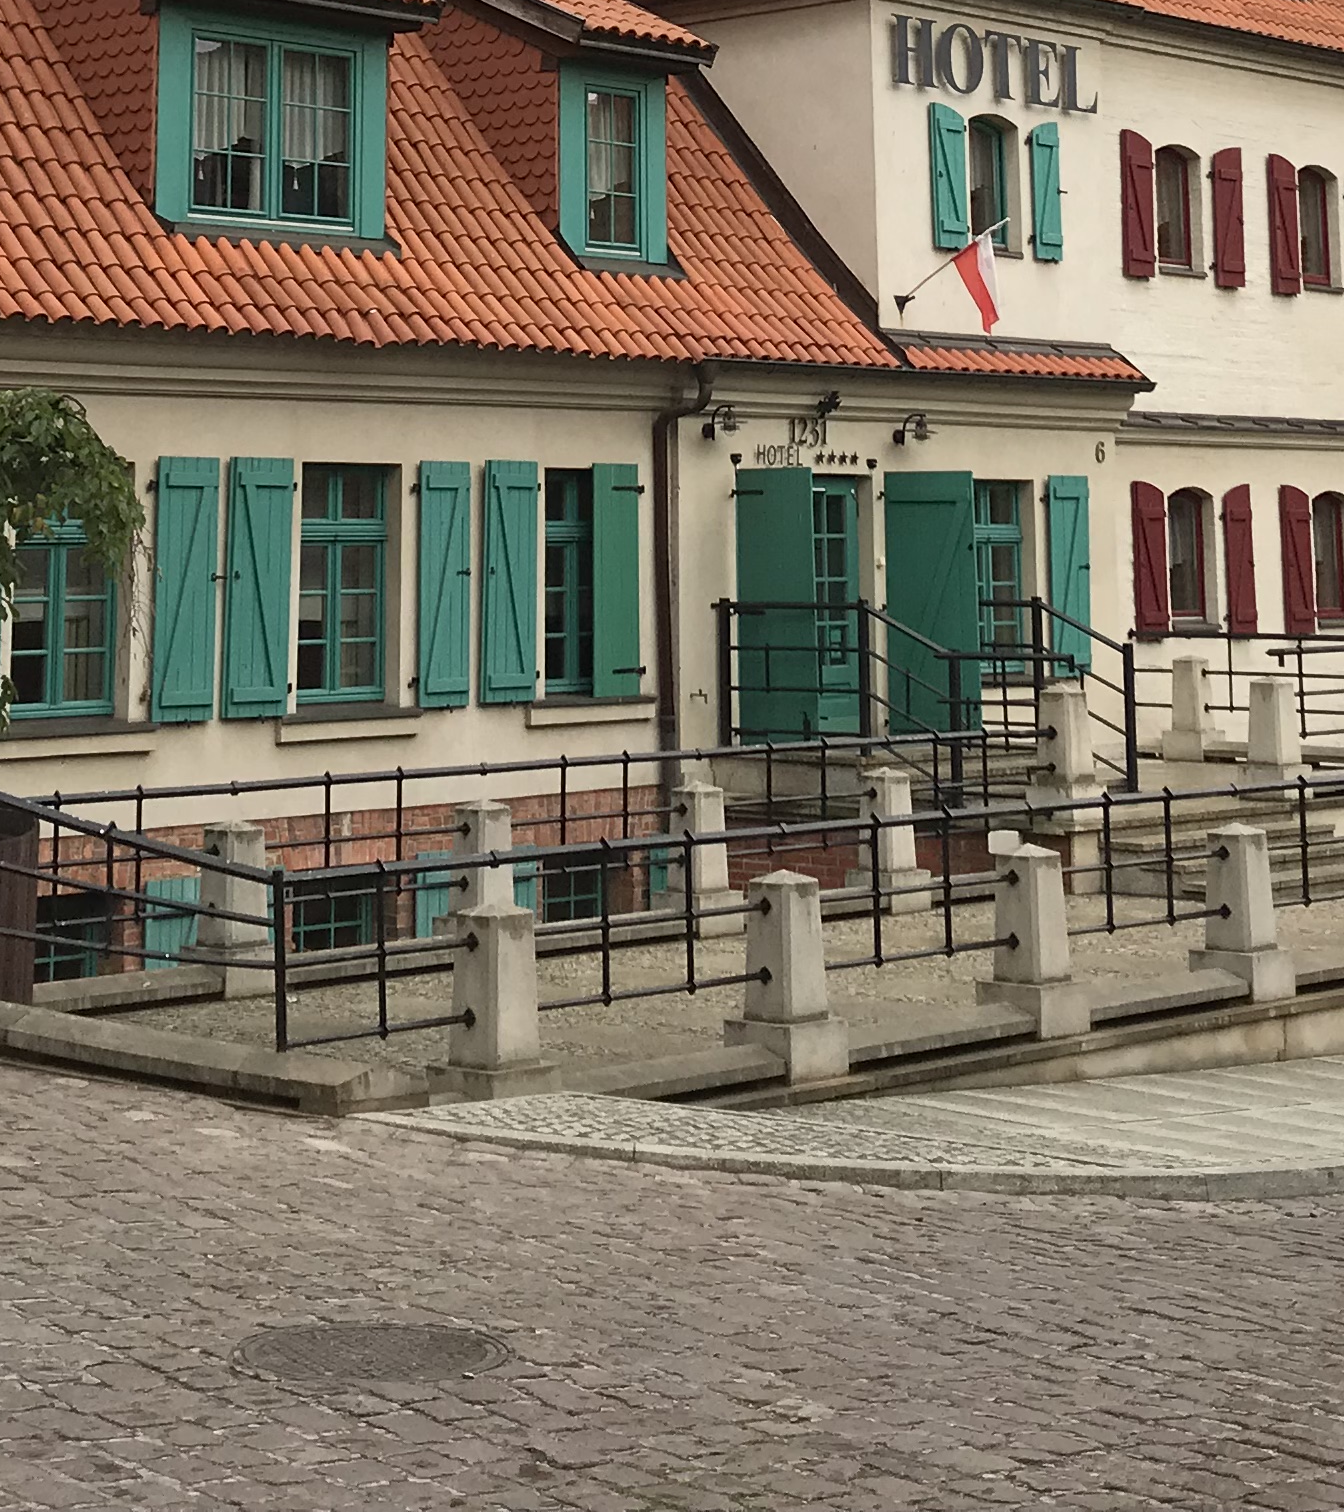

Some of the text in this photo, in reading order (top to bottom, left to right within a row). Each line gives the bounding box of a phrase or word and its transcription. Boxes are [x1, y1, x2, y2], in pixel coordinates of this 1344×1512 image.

[890, 13, 1098, 114] HOTEL
[788, 417, 827, 448] 1231
[756, 444, 803, 467] HOTEL
[1095, 440, 1106, 464] 6
